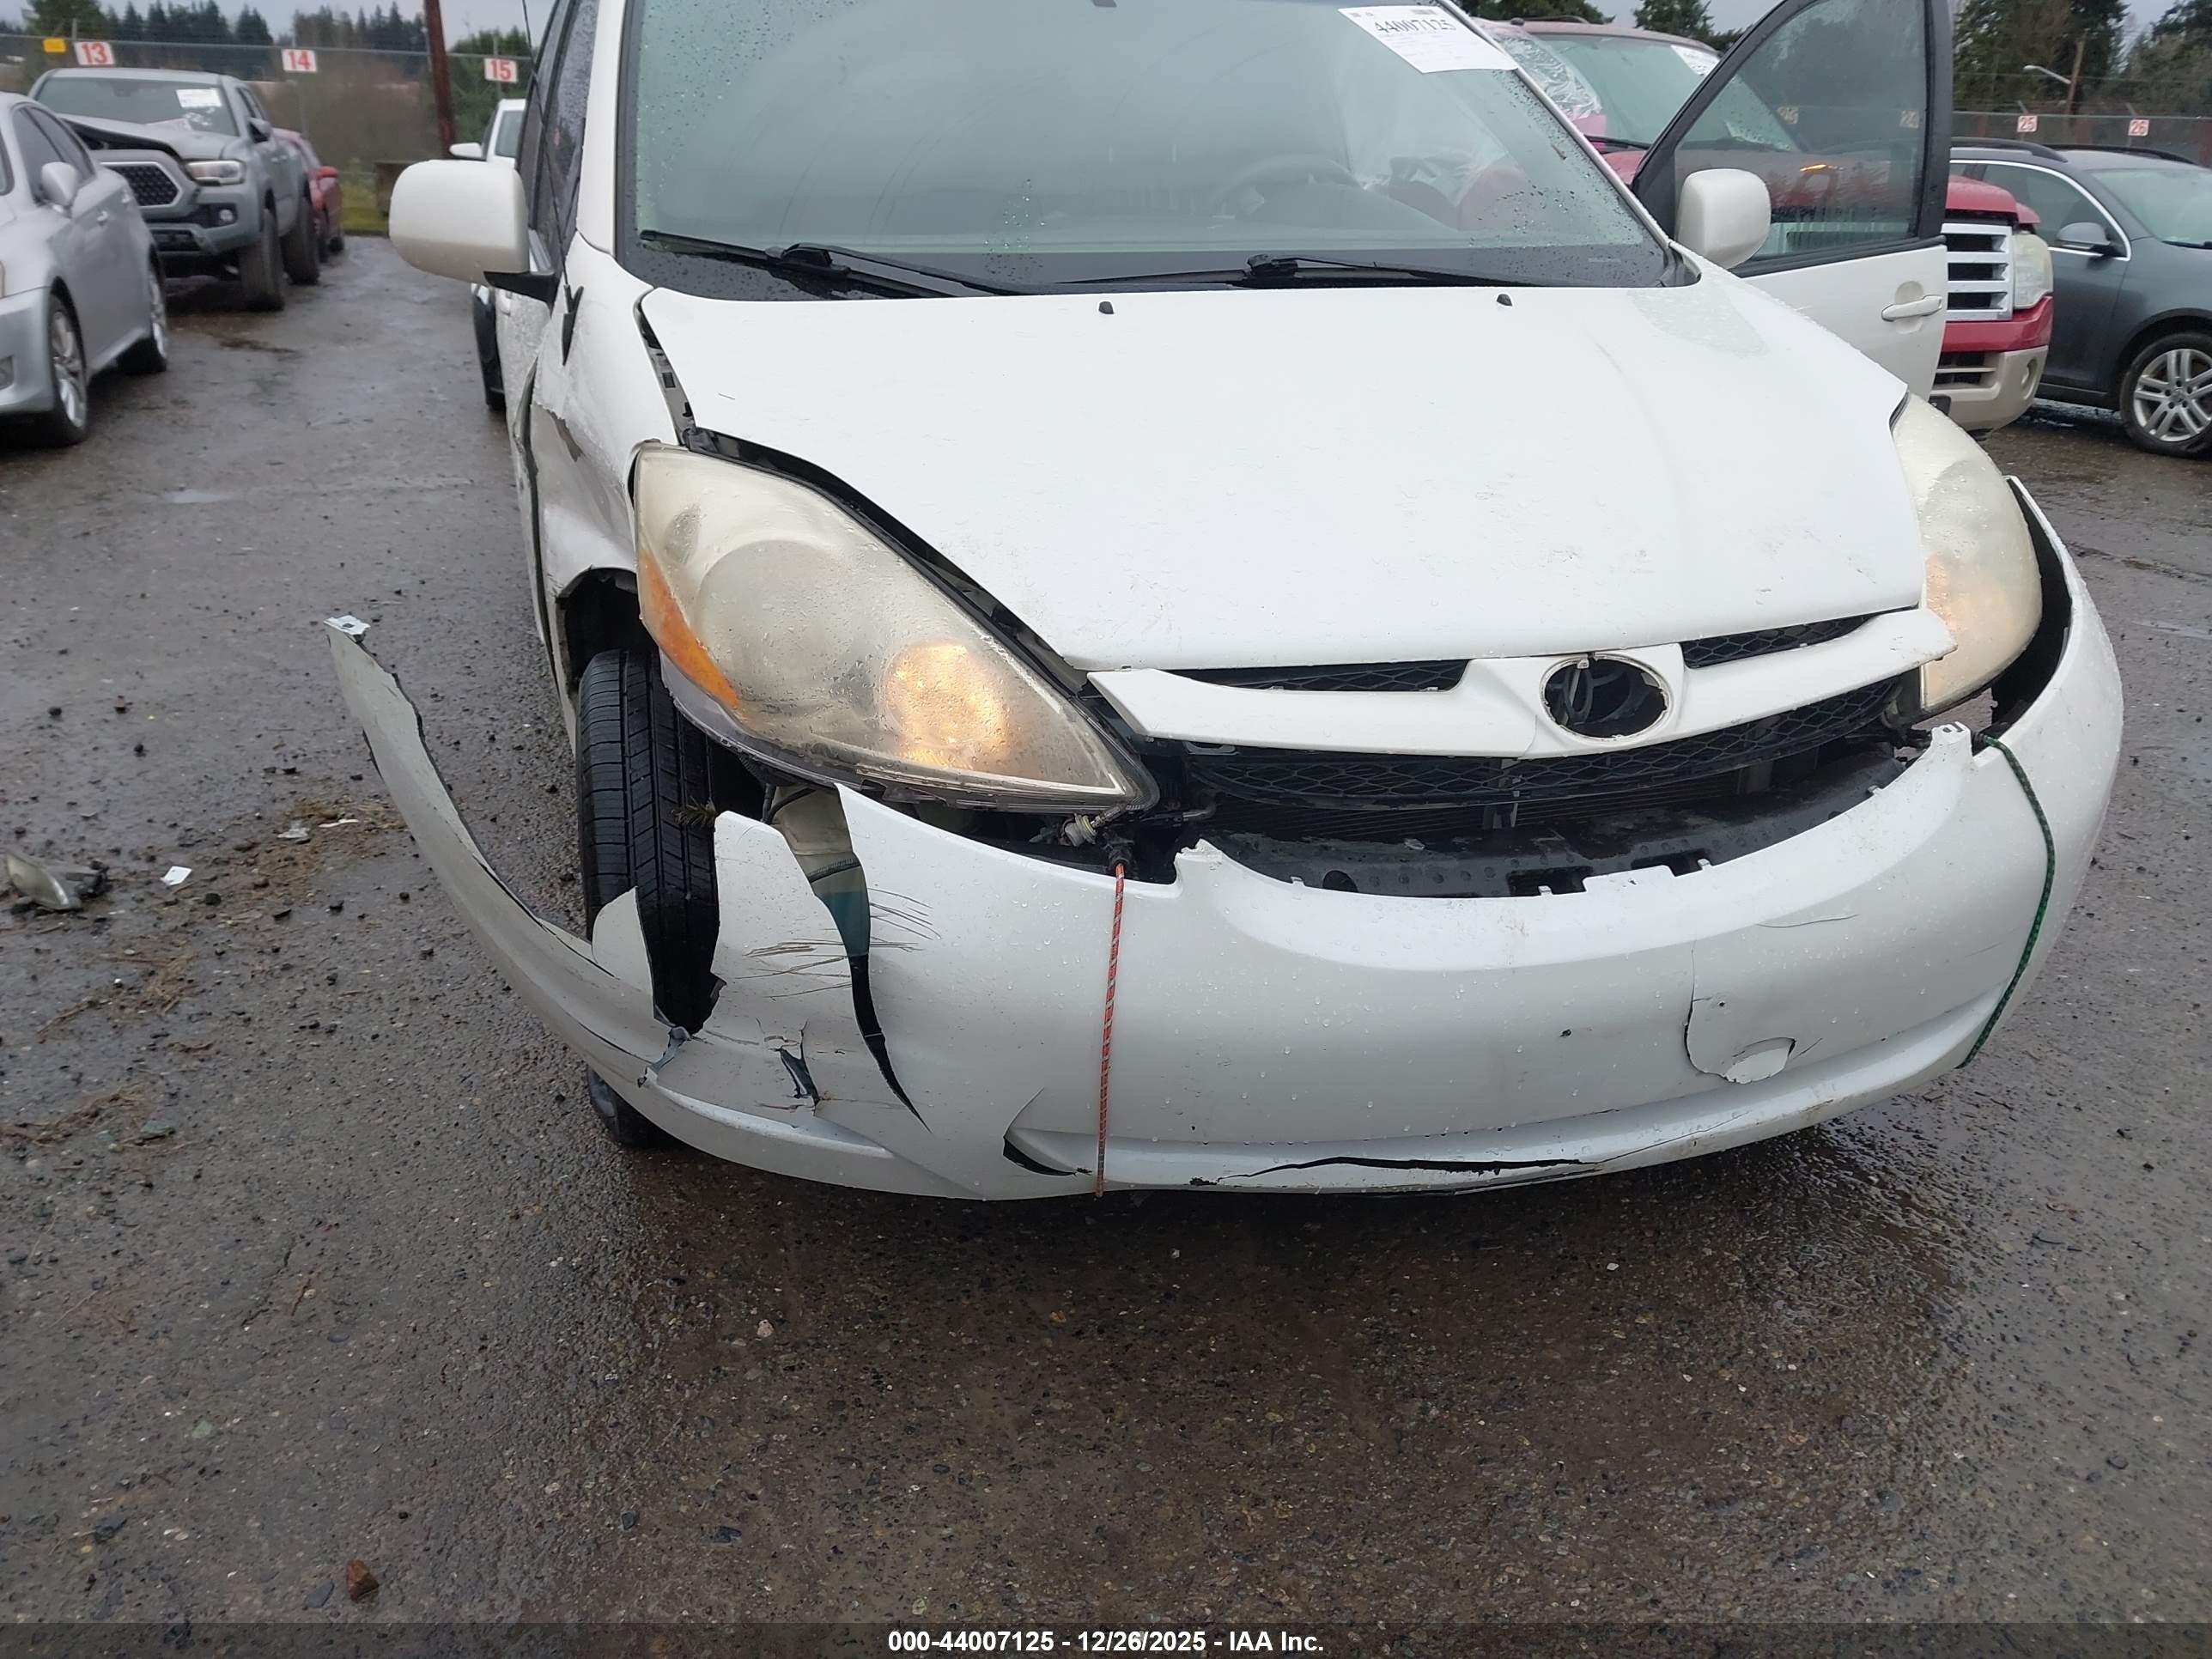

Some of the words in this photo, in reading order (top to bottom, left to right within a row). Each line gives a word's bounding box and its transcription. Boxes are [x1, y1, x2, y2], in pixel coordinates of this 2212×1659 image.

[82, 42, 107, 64] 13
[288, 50, 311, 70] 14
[490, 59, 512, 81] 15
[2019, 117, 2035, 131] 25
[2130, 121, 2148, 135] 26
